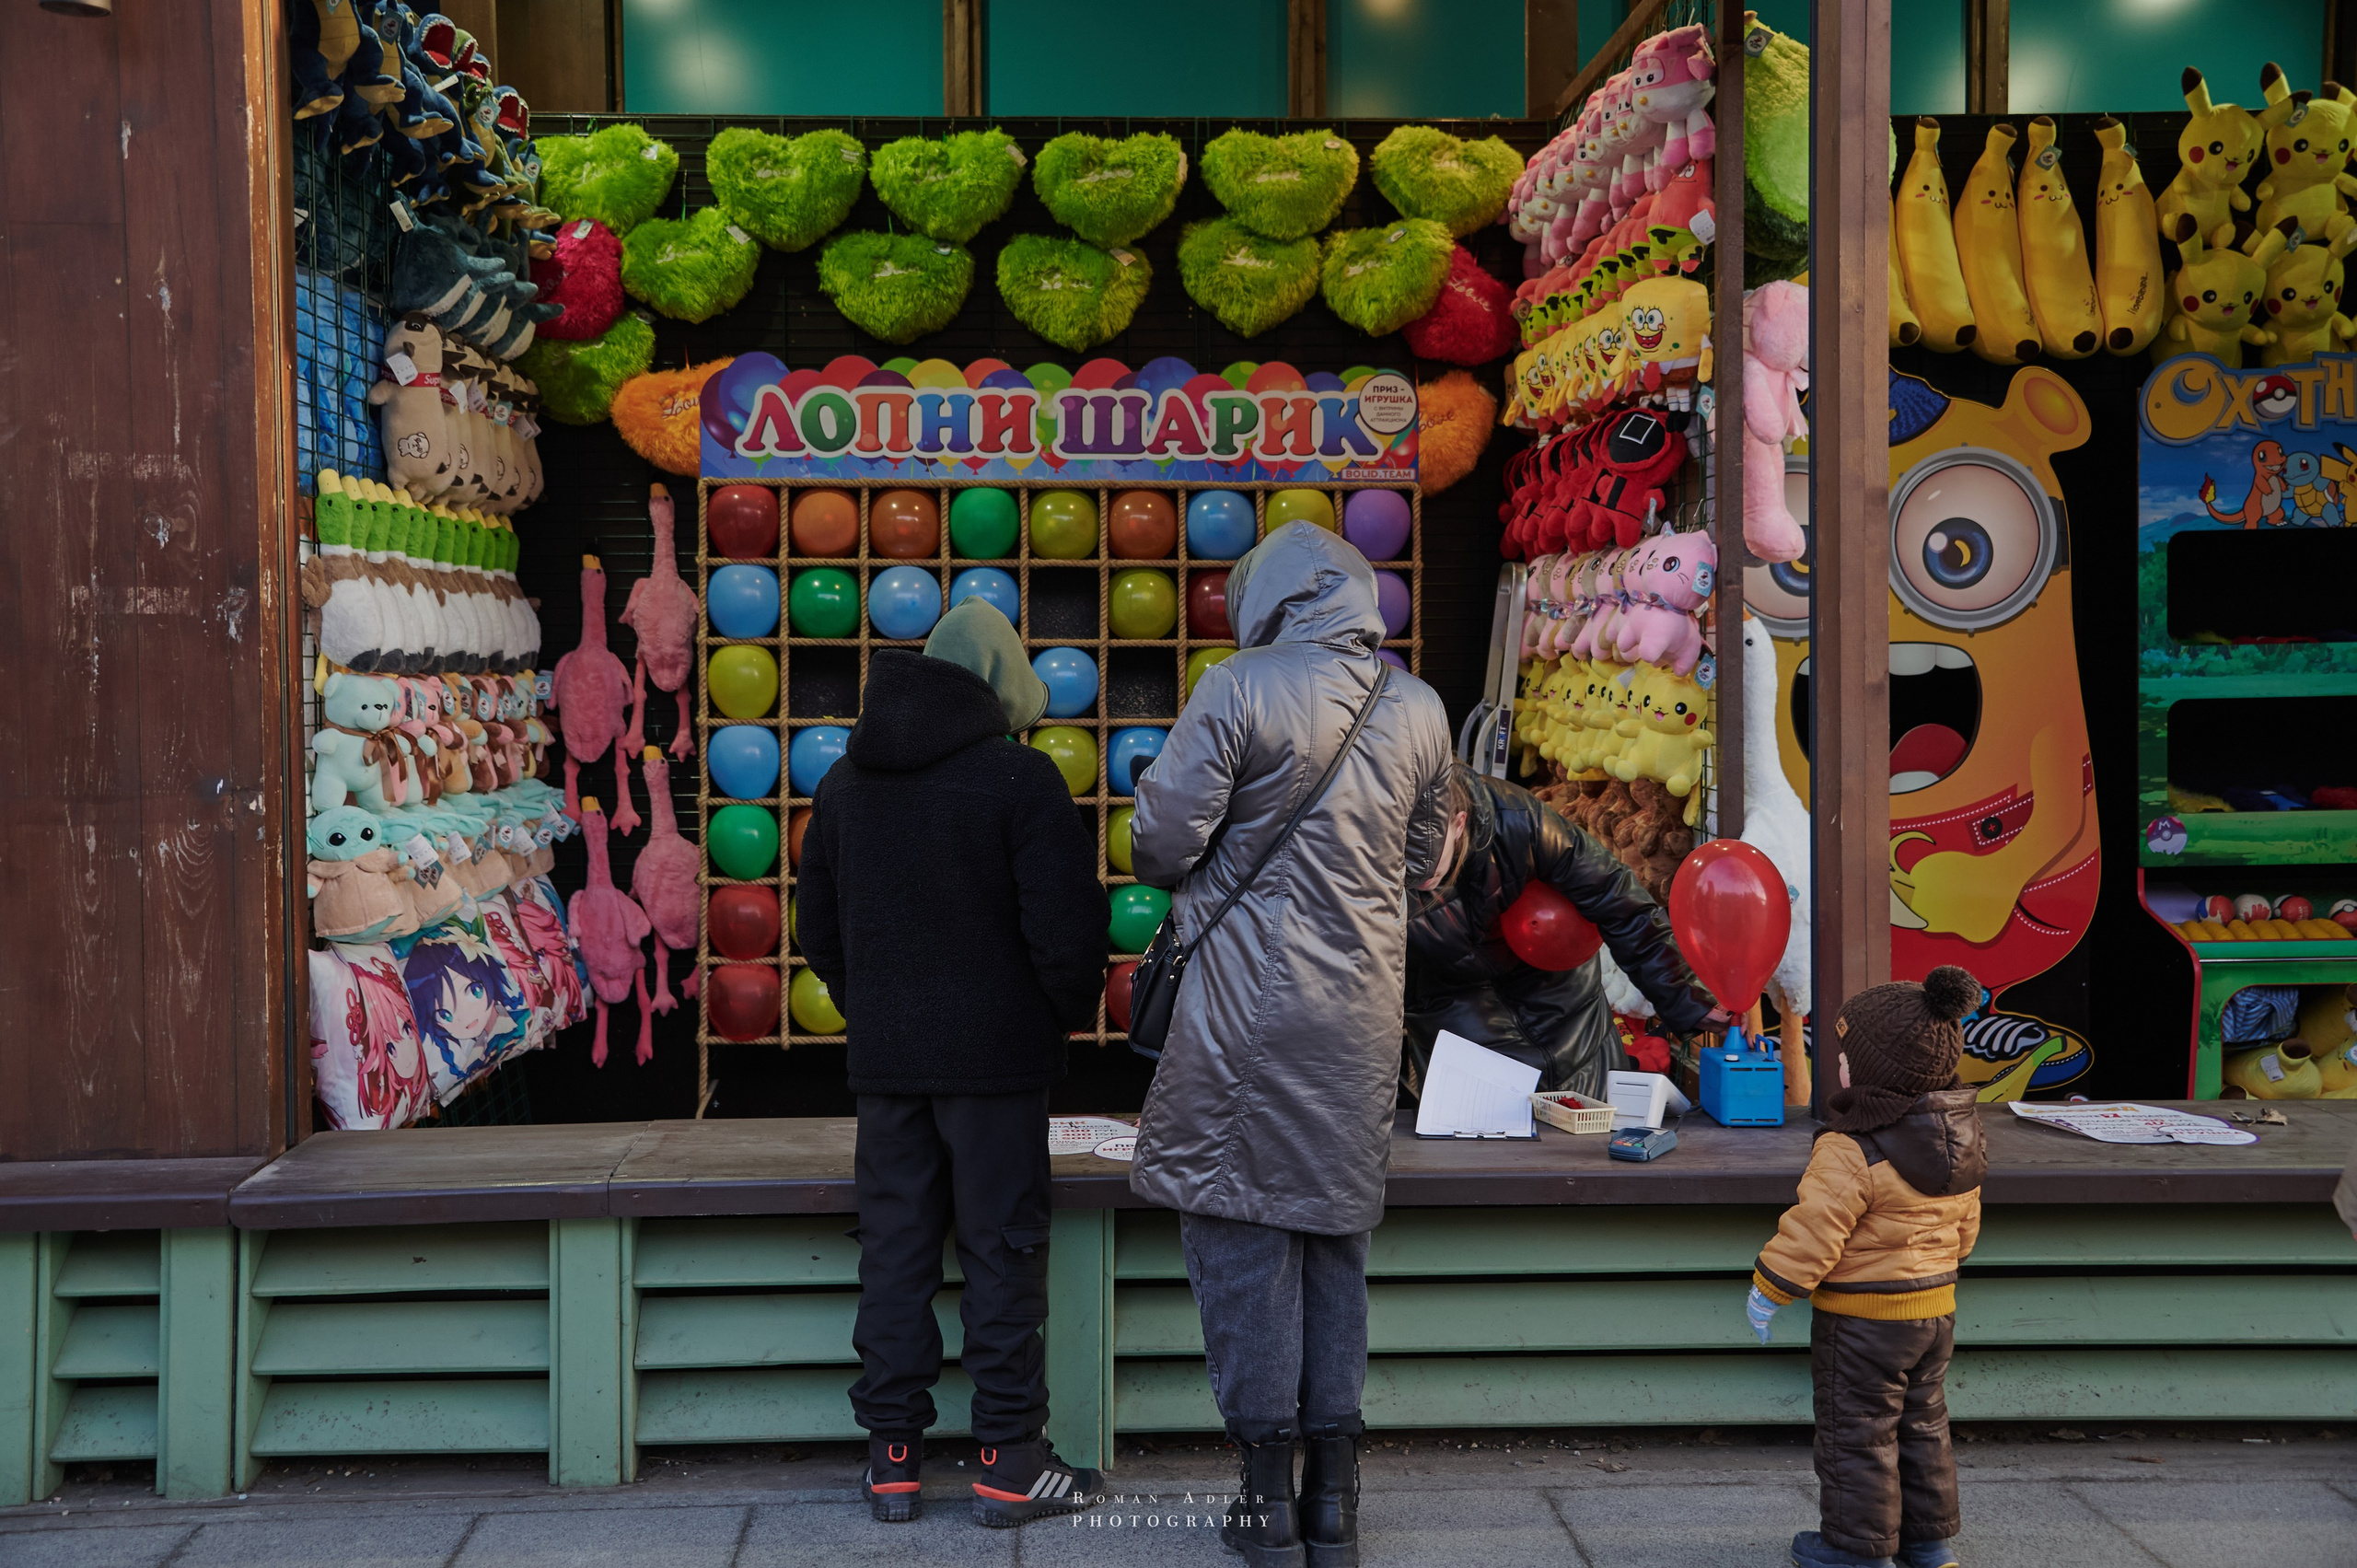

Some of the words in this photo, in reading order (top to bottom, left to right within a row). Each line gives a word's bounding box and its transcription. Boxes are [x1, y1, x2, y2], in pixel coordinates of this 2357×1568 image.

[1223, 246, 1278, 269] Love
[1446, 275, 1492, 311] Love
[660, 393, 701, 419] Lov
[1364, 395, 1413, 403] ИГРУШКА
[742, 391, 1036, 453] ЛОПНИ
[1059, 395, 1378, 456] ШАРИК
[1345, 470, 1411, 479] BOLID.TEAM
